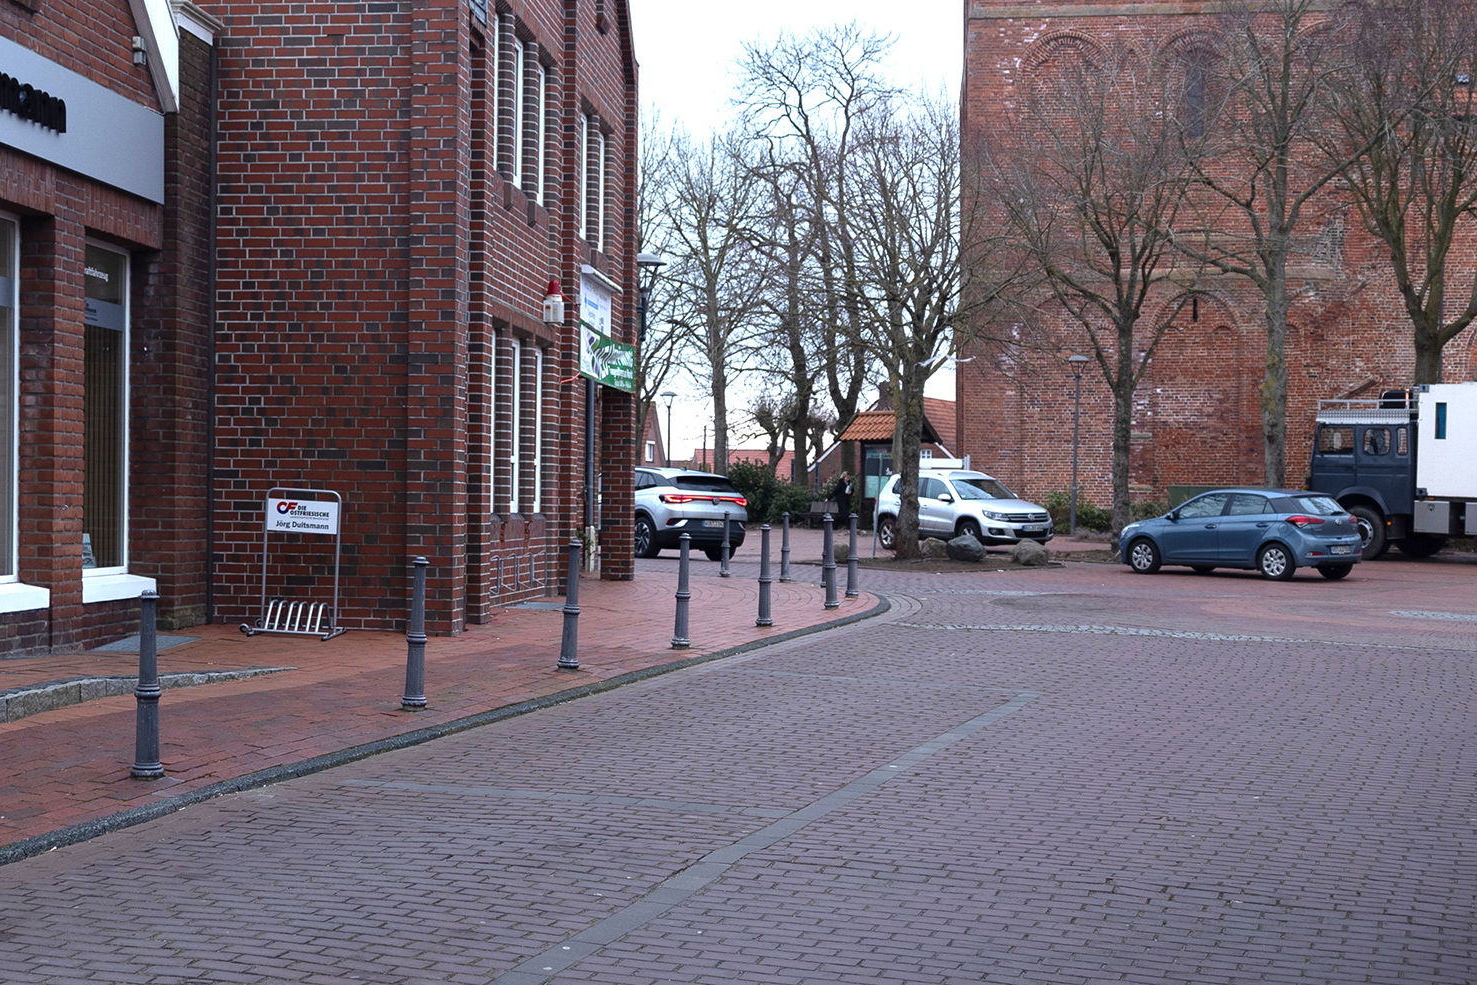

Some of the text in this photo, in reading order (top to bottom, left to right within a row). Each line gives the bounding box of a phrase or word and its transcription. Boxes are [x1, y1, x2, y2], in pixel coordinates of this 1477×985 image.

[290, 510, 329, 518] OSTFRIESISCHE
[276, 519, 329, 530] Jörg Duitsmann
